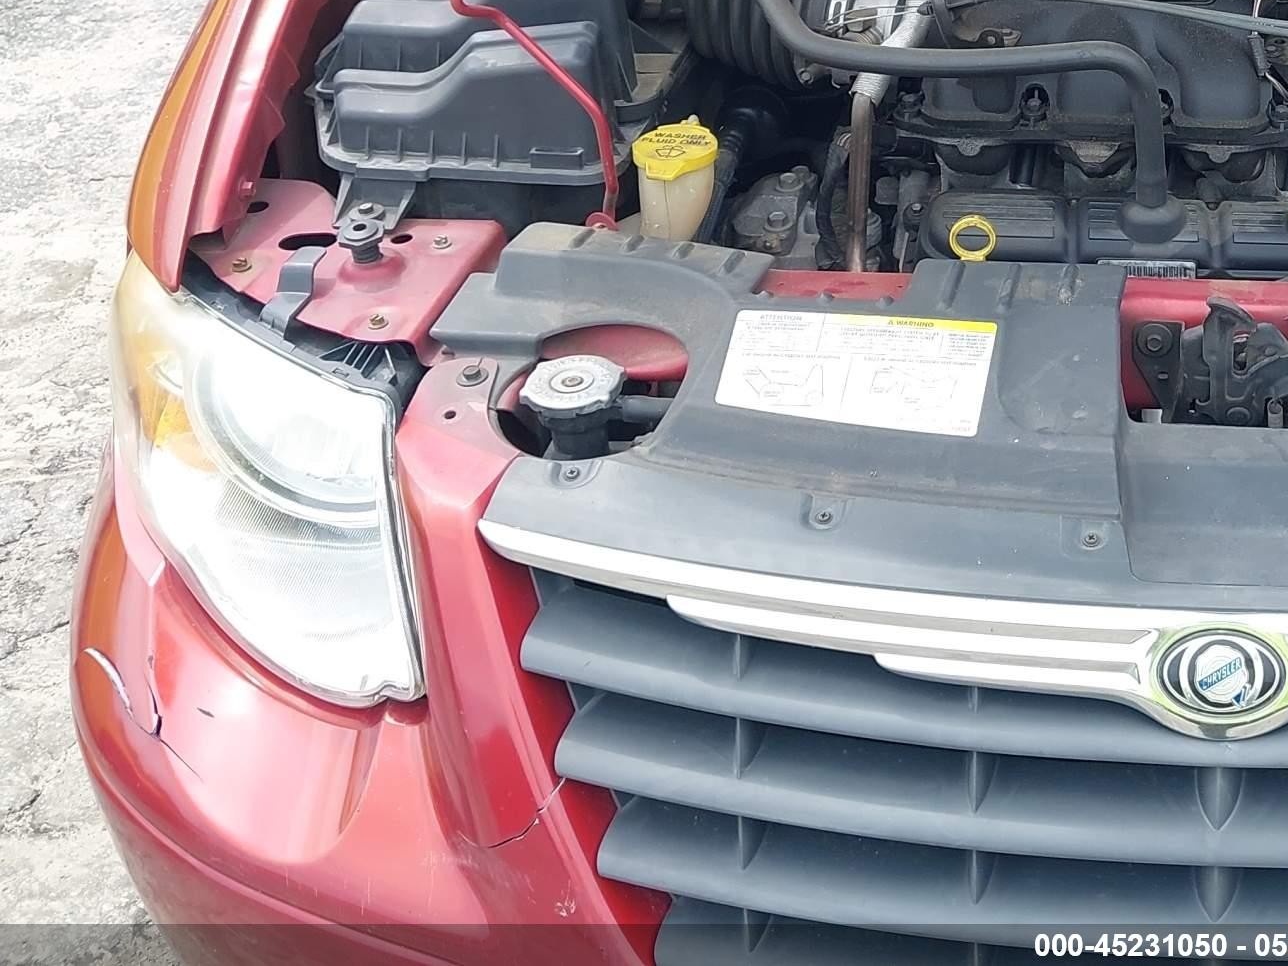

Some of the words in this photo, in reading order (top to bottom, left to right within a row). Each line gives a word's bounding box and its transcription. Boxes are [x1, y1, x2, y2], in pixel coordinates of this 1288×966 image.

[655, 132, 707, 140] WASHER
[896, 320, 935, 328] WARNING
[1202, 657, 1242, 689] CHRYSLER
